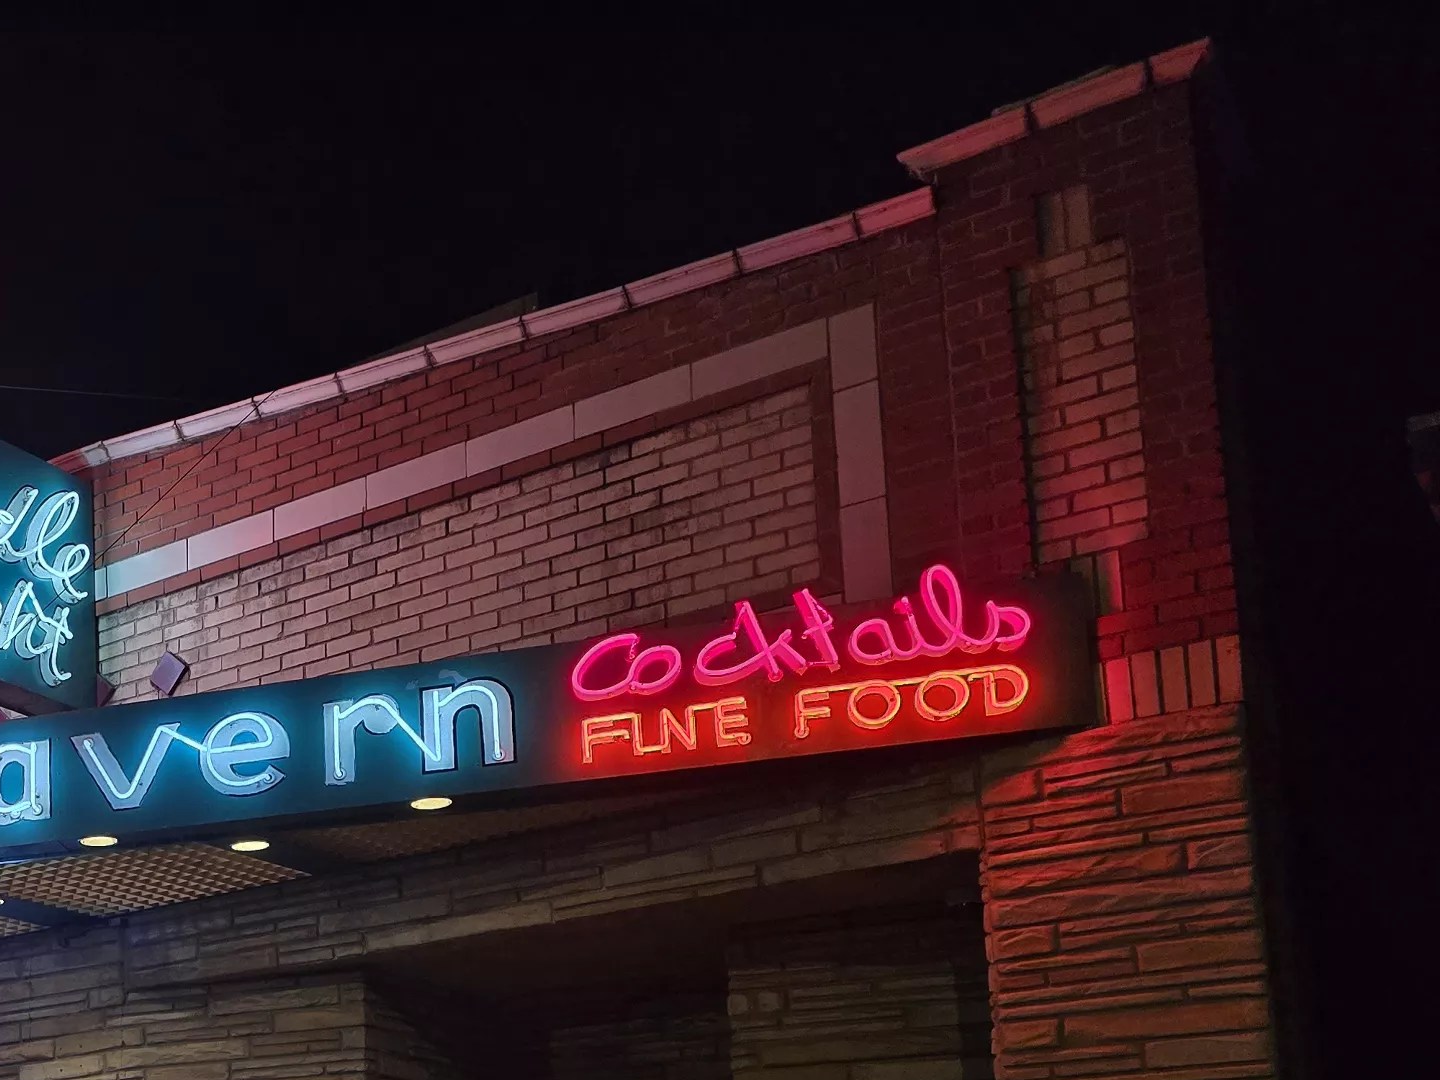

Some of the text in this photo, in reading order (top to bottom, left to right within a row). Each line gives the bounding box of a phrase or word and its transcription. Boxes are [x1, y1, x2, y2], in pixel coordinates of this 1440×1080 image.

[572, 564, 1031, 700] Cocktails
[581, 664, 1029, 764] FINE FOOD
